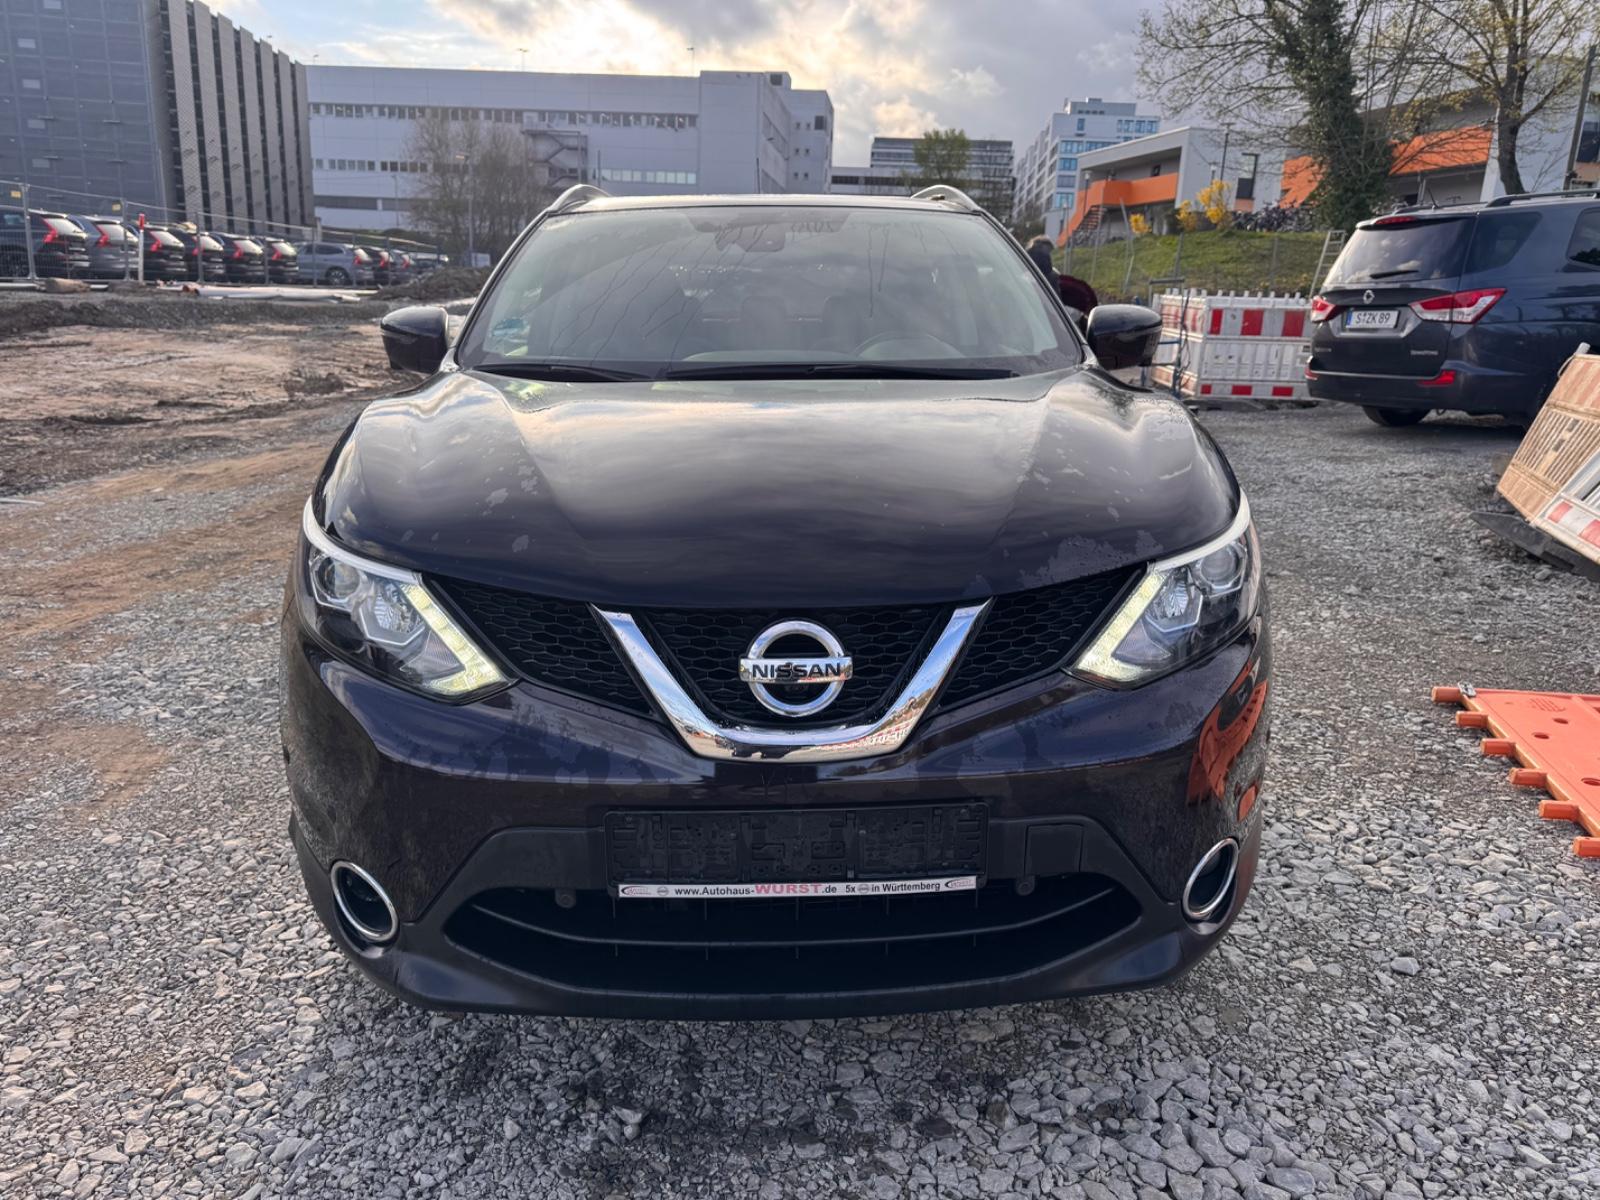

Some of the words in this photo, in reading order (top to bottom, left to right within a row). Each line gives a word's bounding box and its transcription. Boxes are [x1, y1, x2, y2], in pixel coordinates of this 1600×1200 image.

[1378, 312, 1391, 324] 89
[752, 662, 841, 679] NISSAN
[674, 883, 838, 896] www.Autohaus-WURST.de
[845, 885, 856, 893] 5x
[871, 884, 880, 892] in
[882, 881, 941, 893] Württemberg
